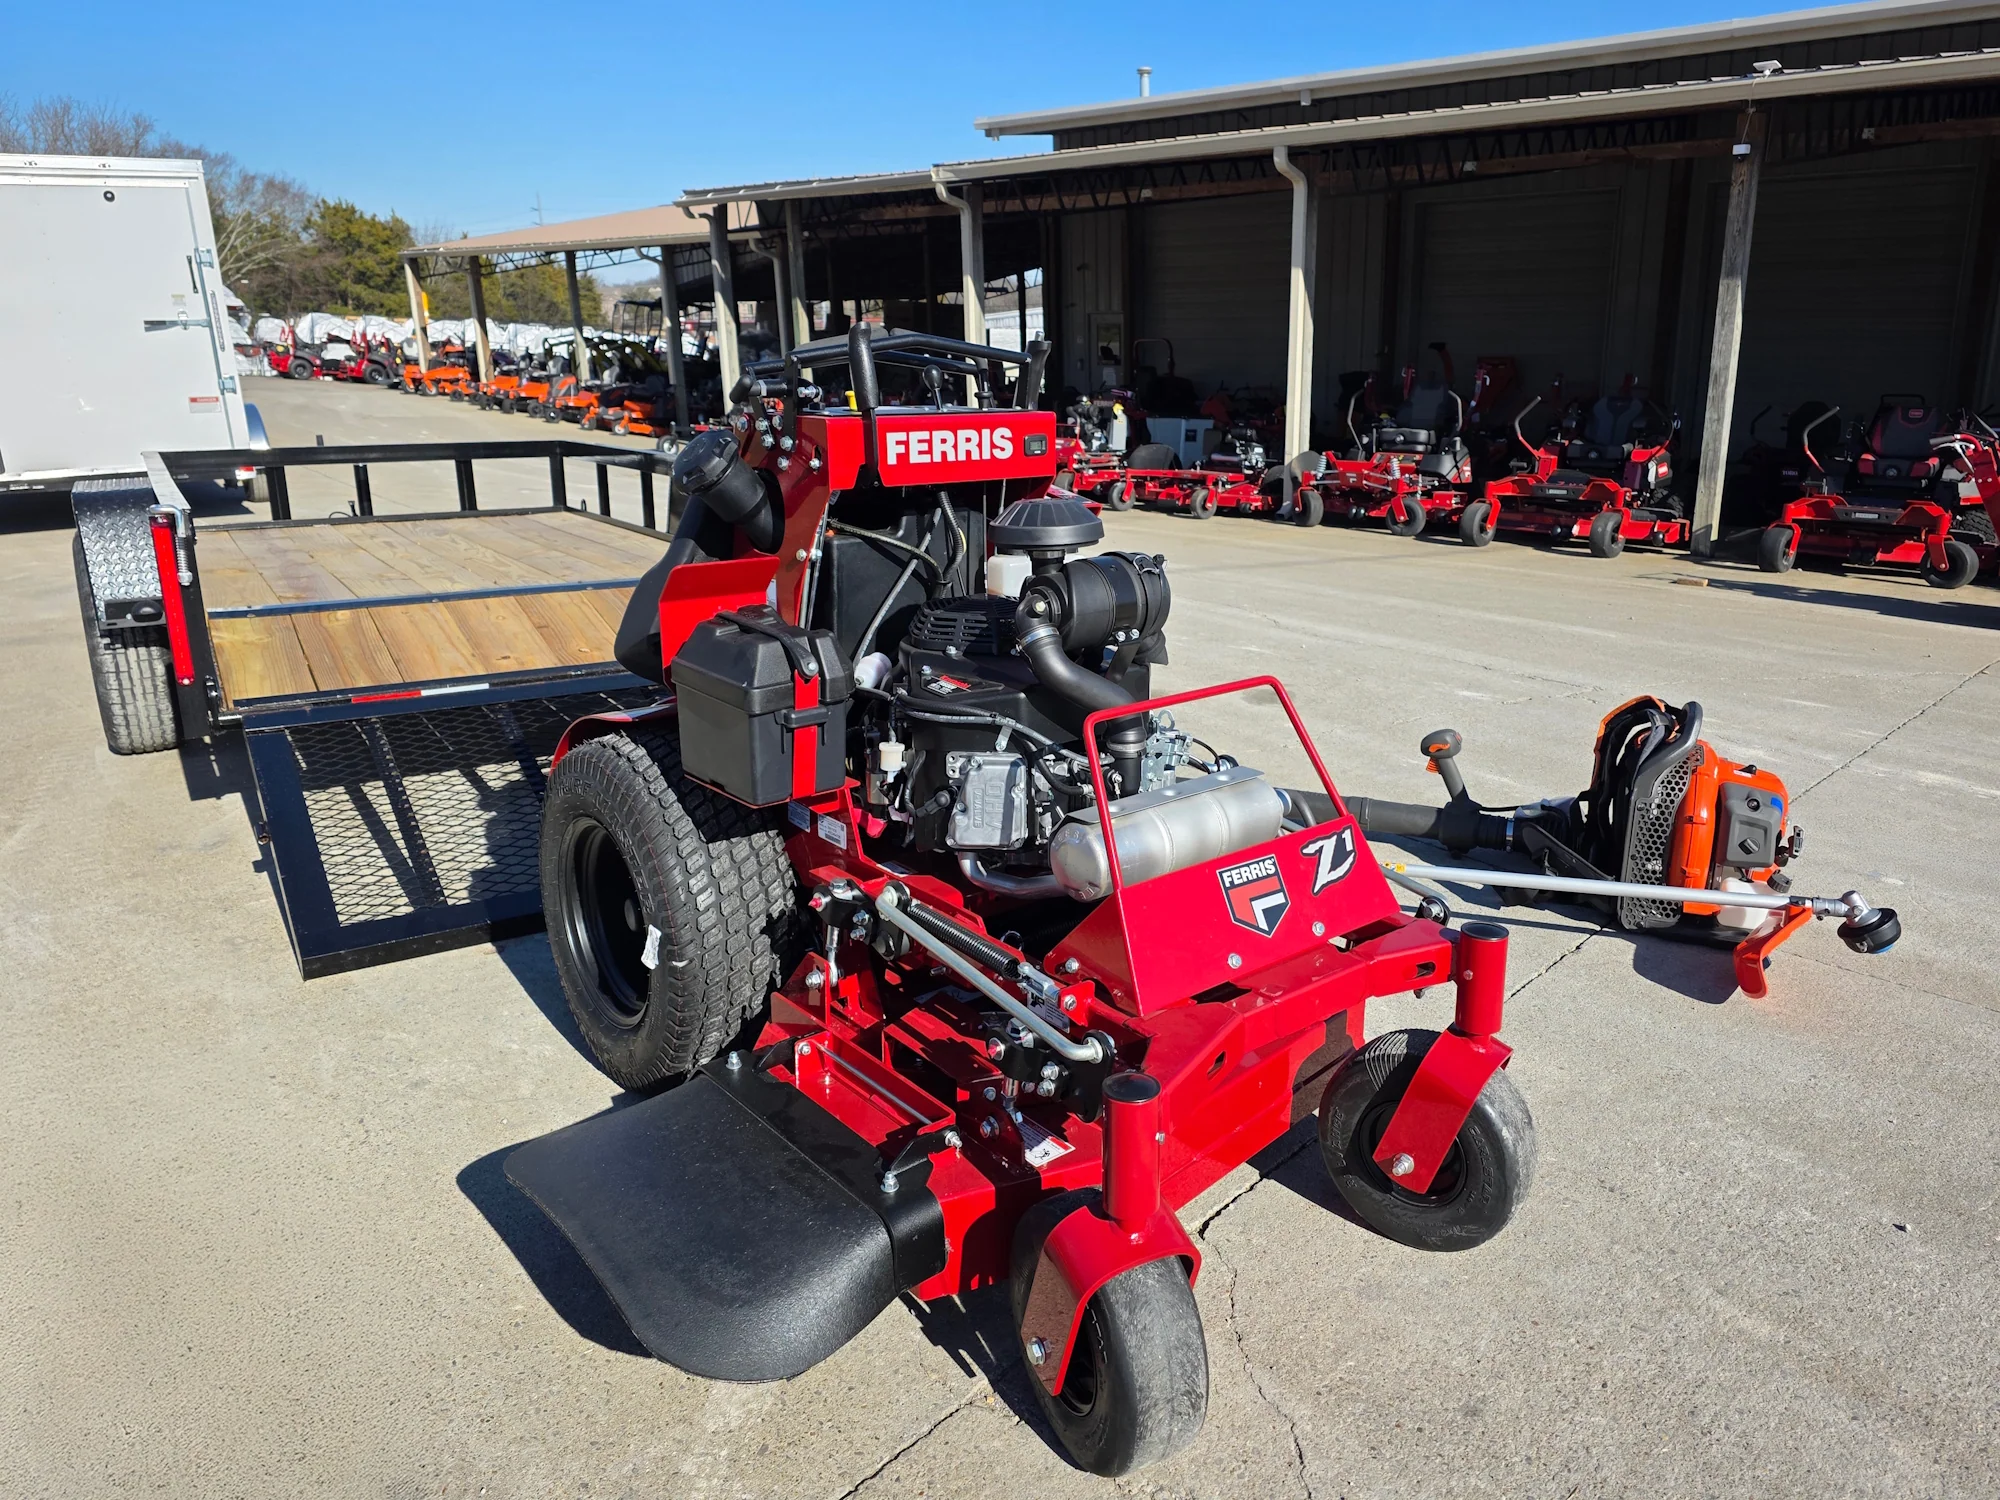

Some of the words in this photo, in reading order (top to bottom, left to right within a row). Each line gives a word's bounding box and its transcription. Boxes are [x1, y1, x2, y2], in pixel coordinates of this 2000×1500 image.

[886, 427, 1014, 466] FERRIS
[985, 781, 1006, 830] OHV
[1222, 857, 1276, 888] FERRIS
[1301, 827, 1356, 894] Z1
[1468, 1124, 1495, 1206] CARLSTAR
